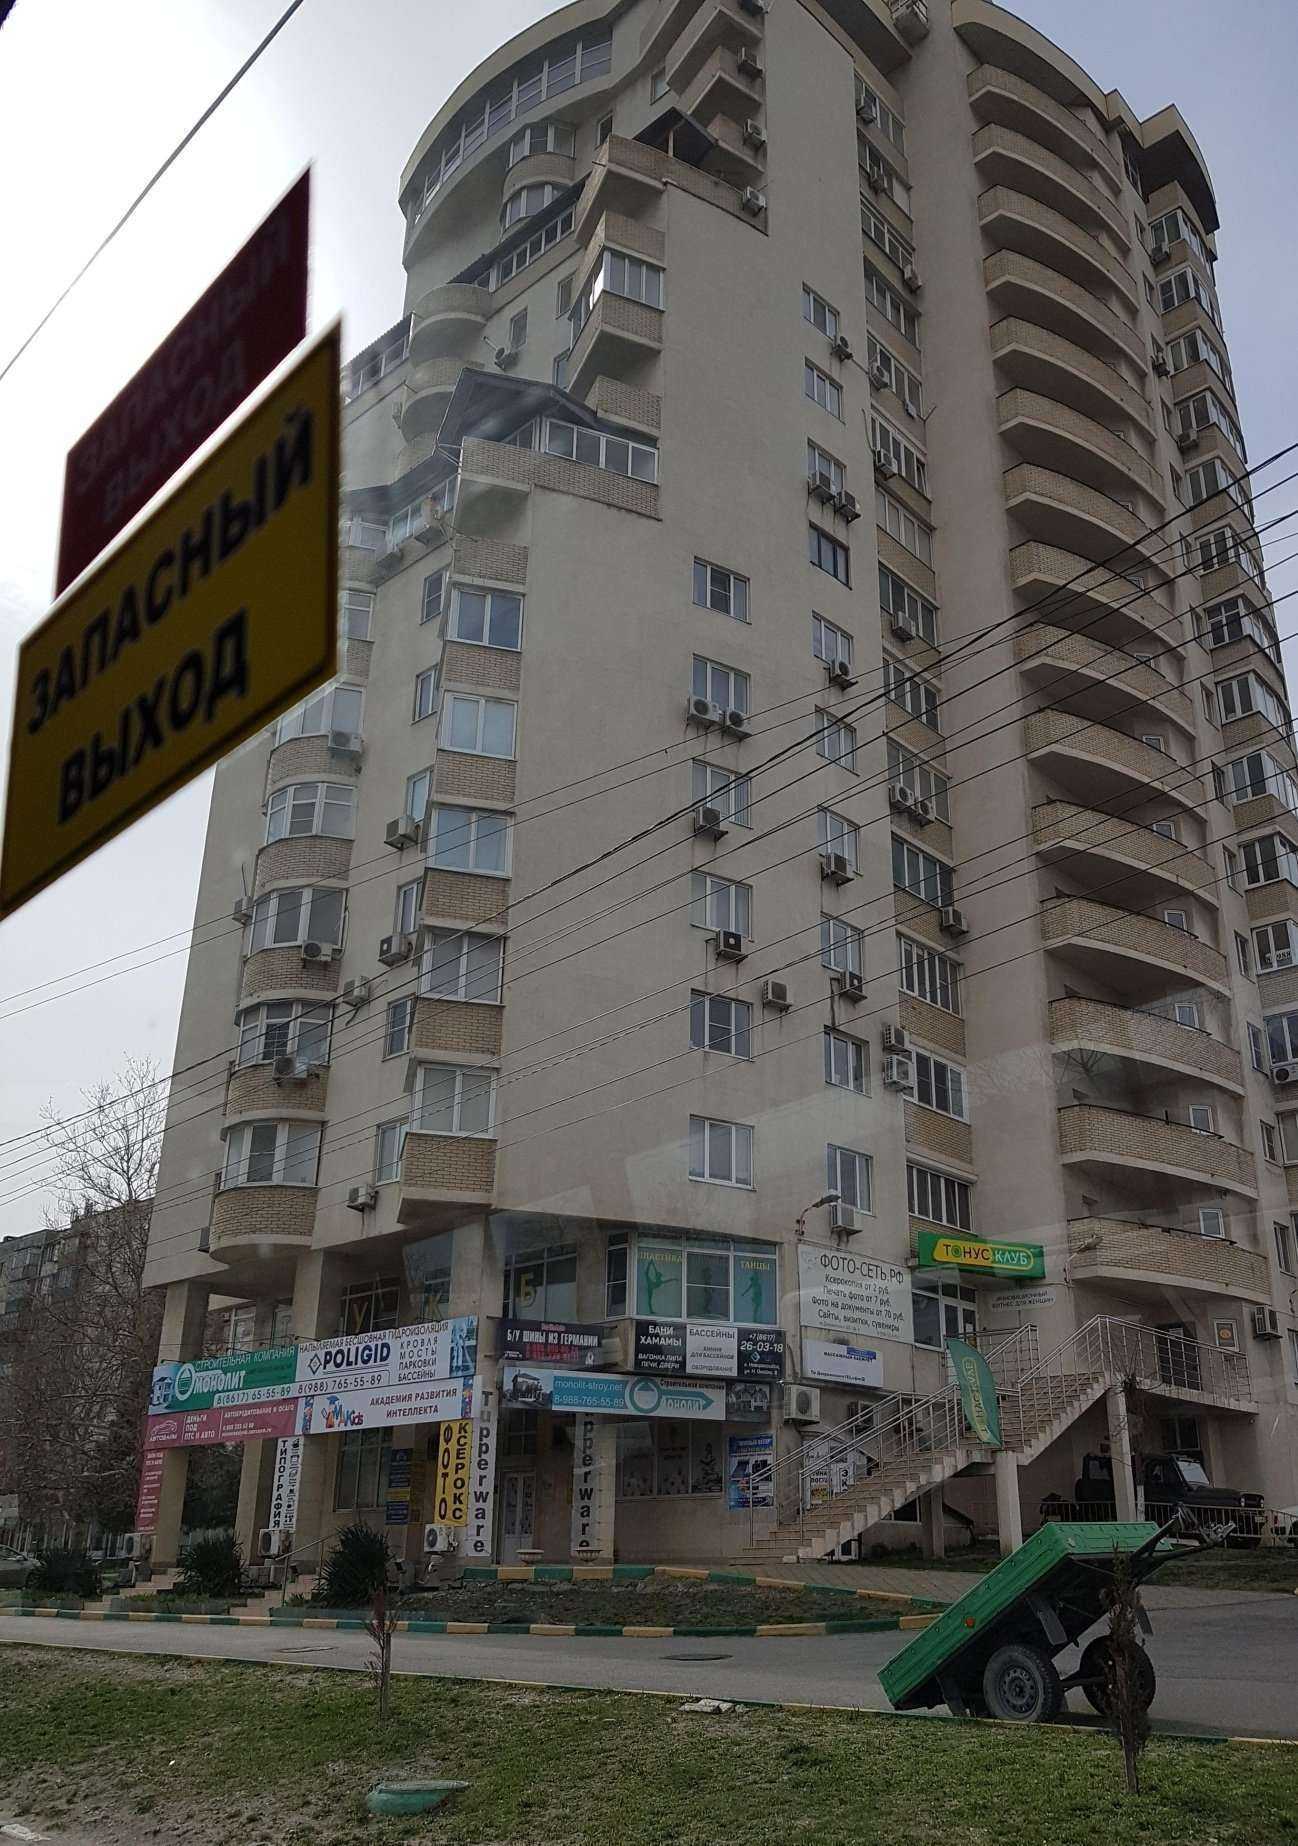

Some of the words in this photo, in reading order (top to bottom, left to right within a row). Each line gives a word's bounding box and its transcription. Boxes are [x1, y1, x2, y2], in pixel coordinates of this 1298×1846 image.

[29, 405, 313, 736] ЗАПАСНЫЙ
[58, 606, 249, 825] ВЫХОД
[943, 1243, 990, 1261] ТОНУС
[995, 1249, 1028, 1265] КЛУБ
[820, 1254, 904, 1285] ФОТО-СЕТЬ.РФ
[823, 1285, 847, 1297] Печать
[848, 1291, 864, 1300] фото
[812, 1296, 829, 1306] Фото
[830, 1300, 839, 1308] на
[840, 1302, 874, 1315] документы
[884, 1309, 892, 1318] 70
[344, 1333, 387, 1346] БЕСШОВНАЯ
[388, 1322, 449, 1340] ГИДРОИЗОЛЯЦИЯ
[507, 1329, 521, 1342] Б/У
[522, 1330, 546, 1343] ШИНЫ
[547, 1332, 558, 1344] ИЗ
[560, 1333, 599, 1347] ГЕРМАНИИ
[639, 1335, 682, 1346] ХАМАМЫ
[648, 1325, 674, 1336] БАНИ
[689, 1328, 736, 1340] БАССЕЙНЫ
[400, 1336, 437, 1349] КРОВЛЯ
[740, 1340, 784, 1353] 26-03-18
[195, 1354, 251, 1371] СТРОИТЕЛЬНАЯ
[253, 1345, 296, 1361] КОМПАНИЯ
[323, 1342, 391, 1370] POLIGID
[398, 1356, 436, 1371] ПАРКОВКИ
[399, 1349, 437, 1360] МОСТЫ
[193, 1370, 246, 1394] МОНОЛИТ
[297, 1380, 329, 1394] 8(988)
[331, 1374, 383, 1391] 765-55-89
[398, 1369, 436, 1383] БАССЕЙНЫ
[554, 1379, 625, 1393] monolit-stroy.net
[369, 1393, 412, 1407] АКАДЕМИЯ
[414, 1387, 457, 1401] РАЗВИТИЯ
[386, 1404, 439, 1418] ИНТЕЛЛЕКТА
[438, 1423, 453, 1521] ФОТО
[452, 1422, 470, 1521] КСЕРОКС
[473, 1390, 494, 1554] Tupperware
[272, 1439, 288, 1529] ТИПОГРАФИЯ
